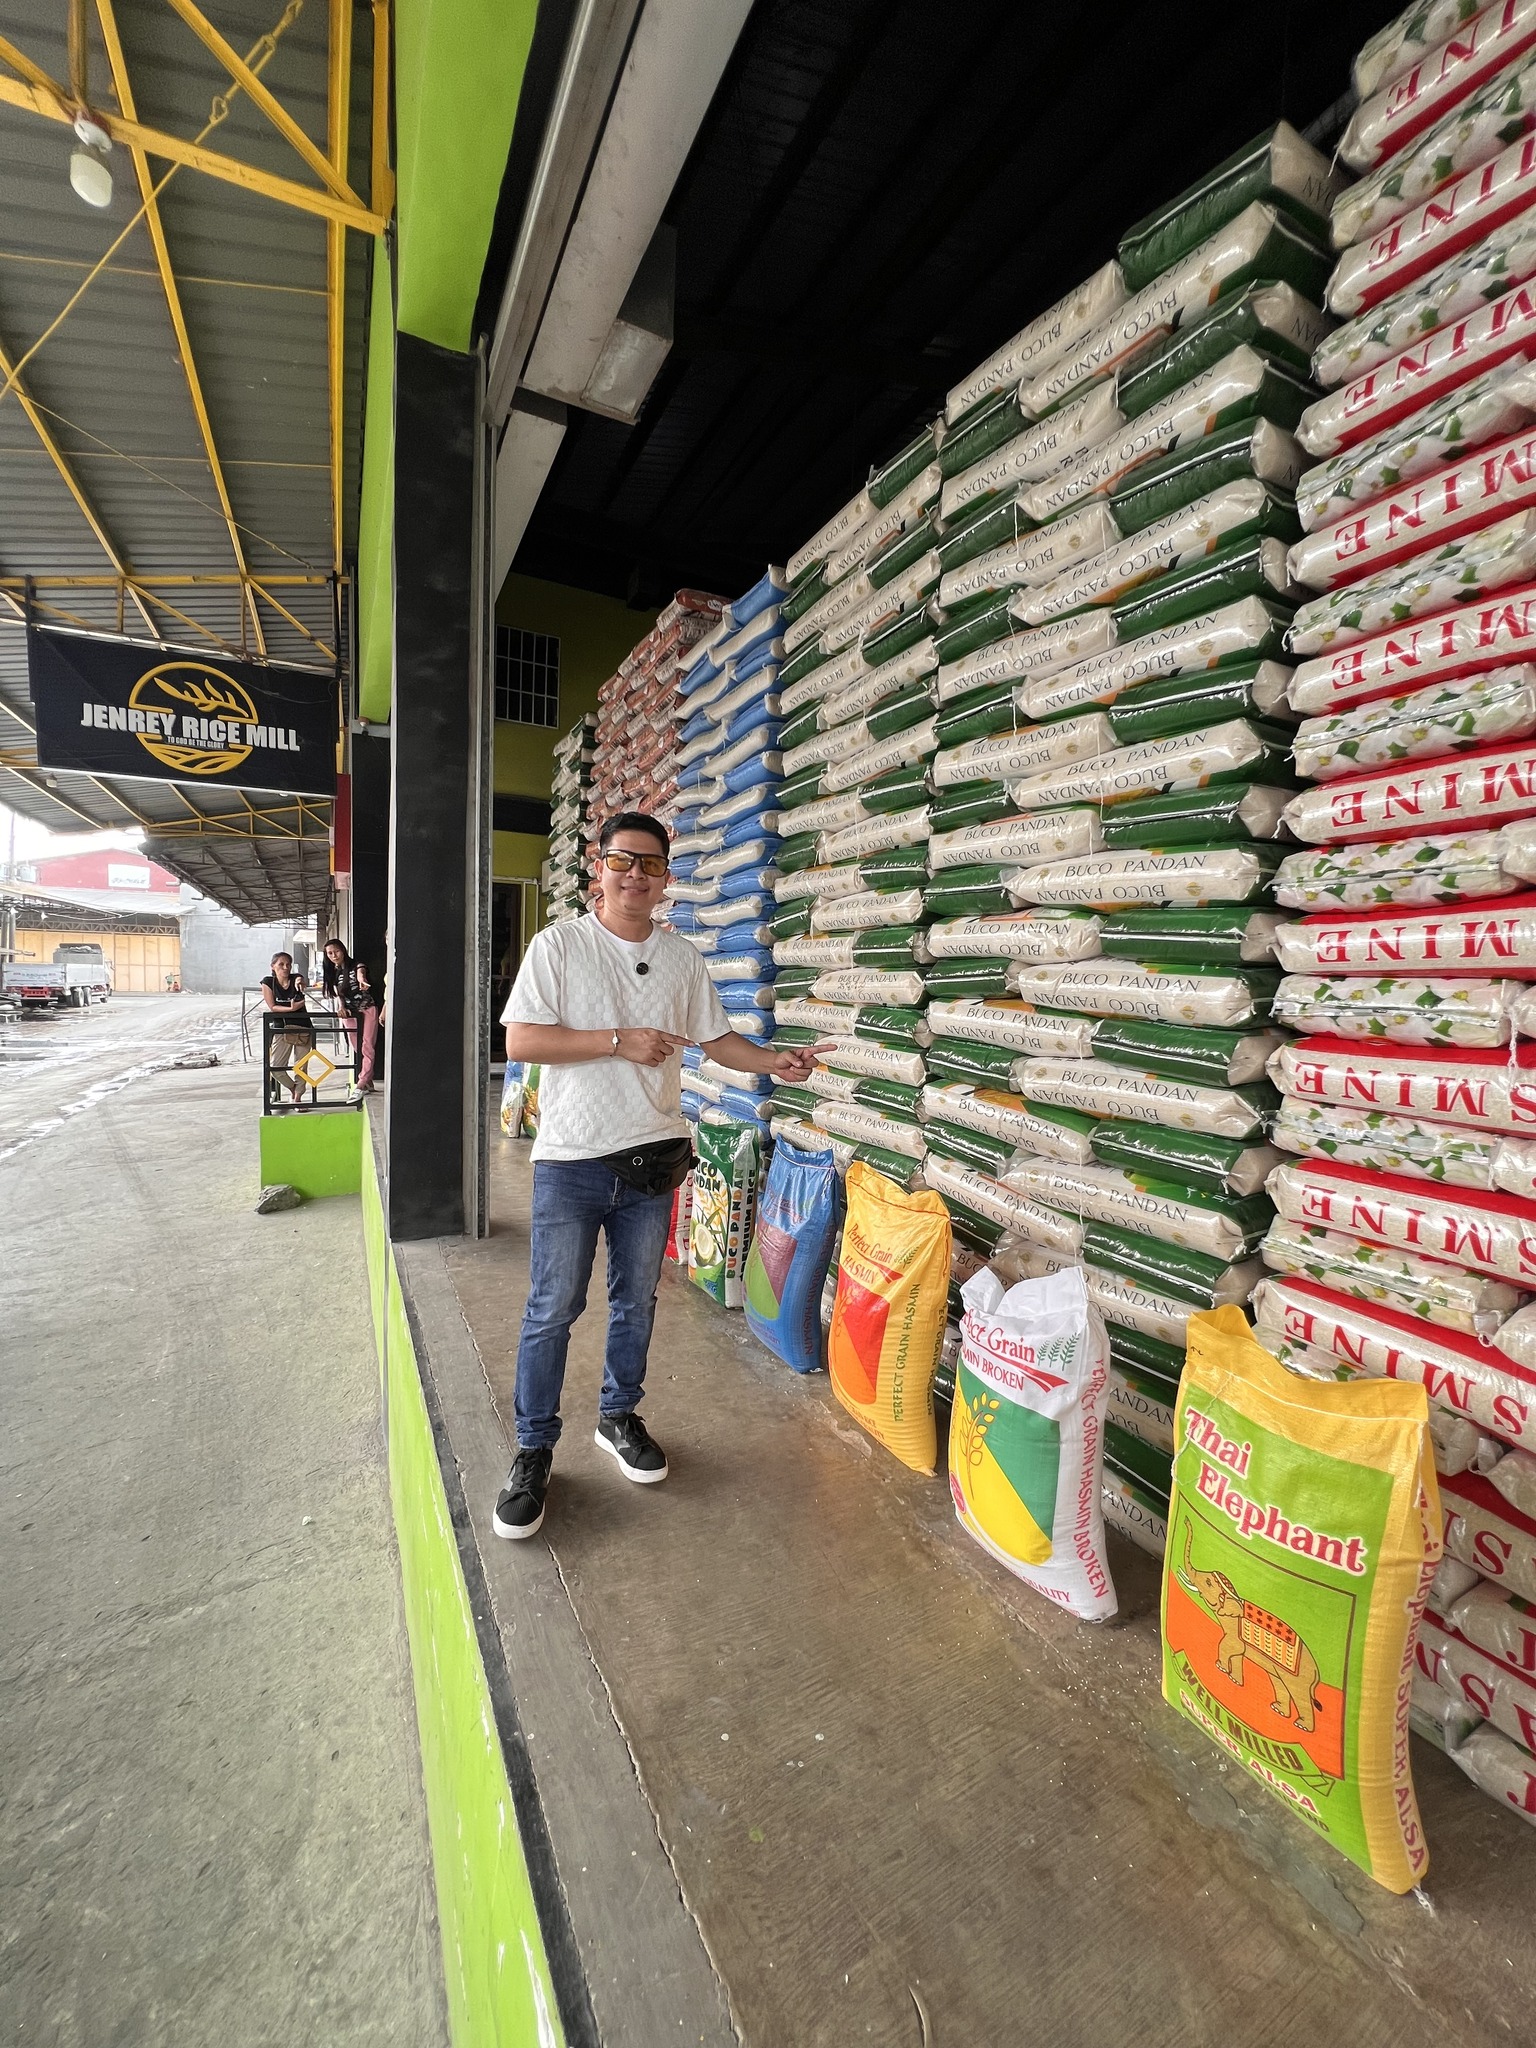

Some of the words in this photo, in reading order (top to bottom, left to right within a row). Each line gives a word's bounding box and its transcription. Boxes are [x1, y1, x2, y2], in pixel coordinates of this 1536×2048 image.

[1123, 292, 1178, 339] BUCO
[1021, 322, 1061, 360] BUCO
[961, 358, 1014, 408] PANDAN
[1045, 340, 1114, 399] PANDAN
[1015, 433, 1057, 467] BUCO
[1120, 418, 1175, 460] BUCO
[955, 463, 1007, 504] PANDAN
[1047, 460, 1111, 511] PANDAN
[1335, 440, 1536, 562] MINE
[826, 516, 848, 541] BUCO
[875, 510, 901, 538] BUCO
[793, 541, 822, 572] PANDAN
[839, 539, 870, 570] PANDAN
[1016, 547, 1054, 571] BUCO
[1119, 539, 1175, 576] BUCO
[955, 571, 1006, 597] PANDAN
[1042, 573, 1109, 616] PANDAN
[827, 595, 850, 617] BUCO
[874, 591, 900, 616] BUCO
[793, 619, 825, 644] PANDAN
[835, 619, 870, 643] PANDAN
[977, 641, 1014, 662] BUCO
[1021, 619, 1080, 646] PANDAN
[1075, 651, 1123, 677] BUCO
[1133, 612, 1219, 652] PANDAN
[1331, 600, 1536, 690] MINE
[1014, 648, 1052, 670] BUCO
[1123, 650, 1176, 679] BUCO
[874, 676, 899, 696] BUCO
[954, 665, 1005, 691] PANDAN
[835, 695, 869, 720] PANDAN
[1045, 679, 1113, 710] PANDAN
[81, 702, 176, 735] JENREY
[182, 715, 241, 744] RICE
[246, 724, 300, 752] MILL
[972, 740, 1010, 756] BUCO
[1017, 720, 1078, 746] PANDAN
[176, 737, 188, 746] GOD
[188, 738, 195, 746] BE
[195, 739, 206, 747] THE
[207, 740, 224, 749] GLORY
[1067, 758, 1115, 776] BUCO
[1126, 732, 1208, 762] PANDAN
[875, 751, 902, 767] BUCO
[950, 761, 1000, 780] PANDAN
[1010, 749, 1051, 769] BUCO
[838, 767, 871, 787] PANDAN
[1039, 780, 1106, 804] PANDAN
[1114, 765, 1168, 789] BUCO
[1331, 760, 1536, 828] MINE
[868, 836, 894, 848] BUCO
[964, 825, 1001, 840] BUCO
[1008, 815, 1068, 834] PANDAN
[831, 843, 865, 858] PANDAN
[942, 848, 992, 864] PANDAN
[1000, 842, 1040, 857] BUCO
[1065, 862, 1112, 877] BUCO
[1123, 855, 1207, 873] PANDAN
[1037, 888, 1103, 901] PANDAN
[1113, 885, 1165, 899] BUCO
[964, 923, 1000, 934] BUCO
[1009, 923, 1071, 934] PANDAN
[1316, 919, 1520, 964] MINE
[942, 945, 991, 955] PANDAN
[1000, 945, 1040, 955] BUCO
[838, 975, 859, 983] BUCO
[864, 974, 898, 983] PANDAN
[1062, 973, 1108, 986] BUCO
[1119, 975, 1201, 992] PANDAN
[795, 1005, 815, 1013] BUCO
[819, 1007, 849, 1017] PANDAN
[1034, 993, 1097, 1009] PANDAN
[1109, 999, 1160, 1015] BUCO
[945, 1025, 994, 1040] PANDAN
[966, 1008, 1005, 1021] BUCO
[1012, 1013, 1069, 1030] PANDAN
[838, 1044, 860, 1054] BUCO
[864, 1049, 901, 1062] PANDAN
[1003, 1033, 1041, 1049] BUCO
[815, 1072, 845, 1087] PANDAN
[1061, 1071, 1107, 1087] BUCO
[1117, 1079, 1199, 1101] PANDAN
[1032, 1089, 1096, 1109] PANDAN
[1107, 1101, 1159, 1120] BUCO
[840, 1112, 861, 1123] BUCO
[865, 1118, 902, 1133] PANDAN
[959, 1098, 996, 1117] BUCO
[1002, 1110, 1063, 1139] PANDAN
[730, 1169, 744, 1233] PANDAN
[747, 1169, 757, 1205] RICE
[936, 1182, 985, 1219] PANDAN
[960, 1173, 997, 1201] BUCO
[1003, 1195, 1062, 1227] PANDAN
[1052, 1176, 1099, 1196] BUCO
[1109, 1189, 1188, 1221] PANDAN
[993, 1211, 1031, 1237] BUCO
[726, 1237, 739, 1279] BUCO
[847, 1224, 871, 1254] Perfect
[870, 1243, 893, 1263] Grain
[842, 1255, 879, 1284] HASMIN
[903, 1284, 921, 1329] HASMIN
[1100, 1280, 1176, 1318] PANDAN
[803, 1305, 814, 1355] HASMIN
[987, 1327, 1035, 1363] Grain
[896, 1334, 910, 1369] GRAIN
[982, 1357, 1025, 1391] BROKEN
[1284, 1305, 1528, 1437] SMINE
[894, 1373, 904, 1421] PERFECT
[1109, 1387, 1174, 1428] ANDAN
[1083, 1415, 1097, 1466] GRAIN
[1185, 1408, 1252, 1477] Thai
[1075, 1466, 1094, 1530] HASMIN
[1197, 1462, 1365, 1574] Elephant
[1074, 1530, 1109, 1599] BROKEN
[1182, 1660, 1223, 1725] WELL
[1227, 1716, 1304, 1771] MILLED
[1394, 1682, 1411, 1778] SUPER
[1180, 1689, 1243, 1759] SUPER
[1249, 1758, 1322, 1818] ALSA
[1395, 1786, 1426, 1873] ALSA
